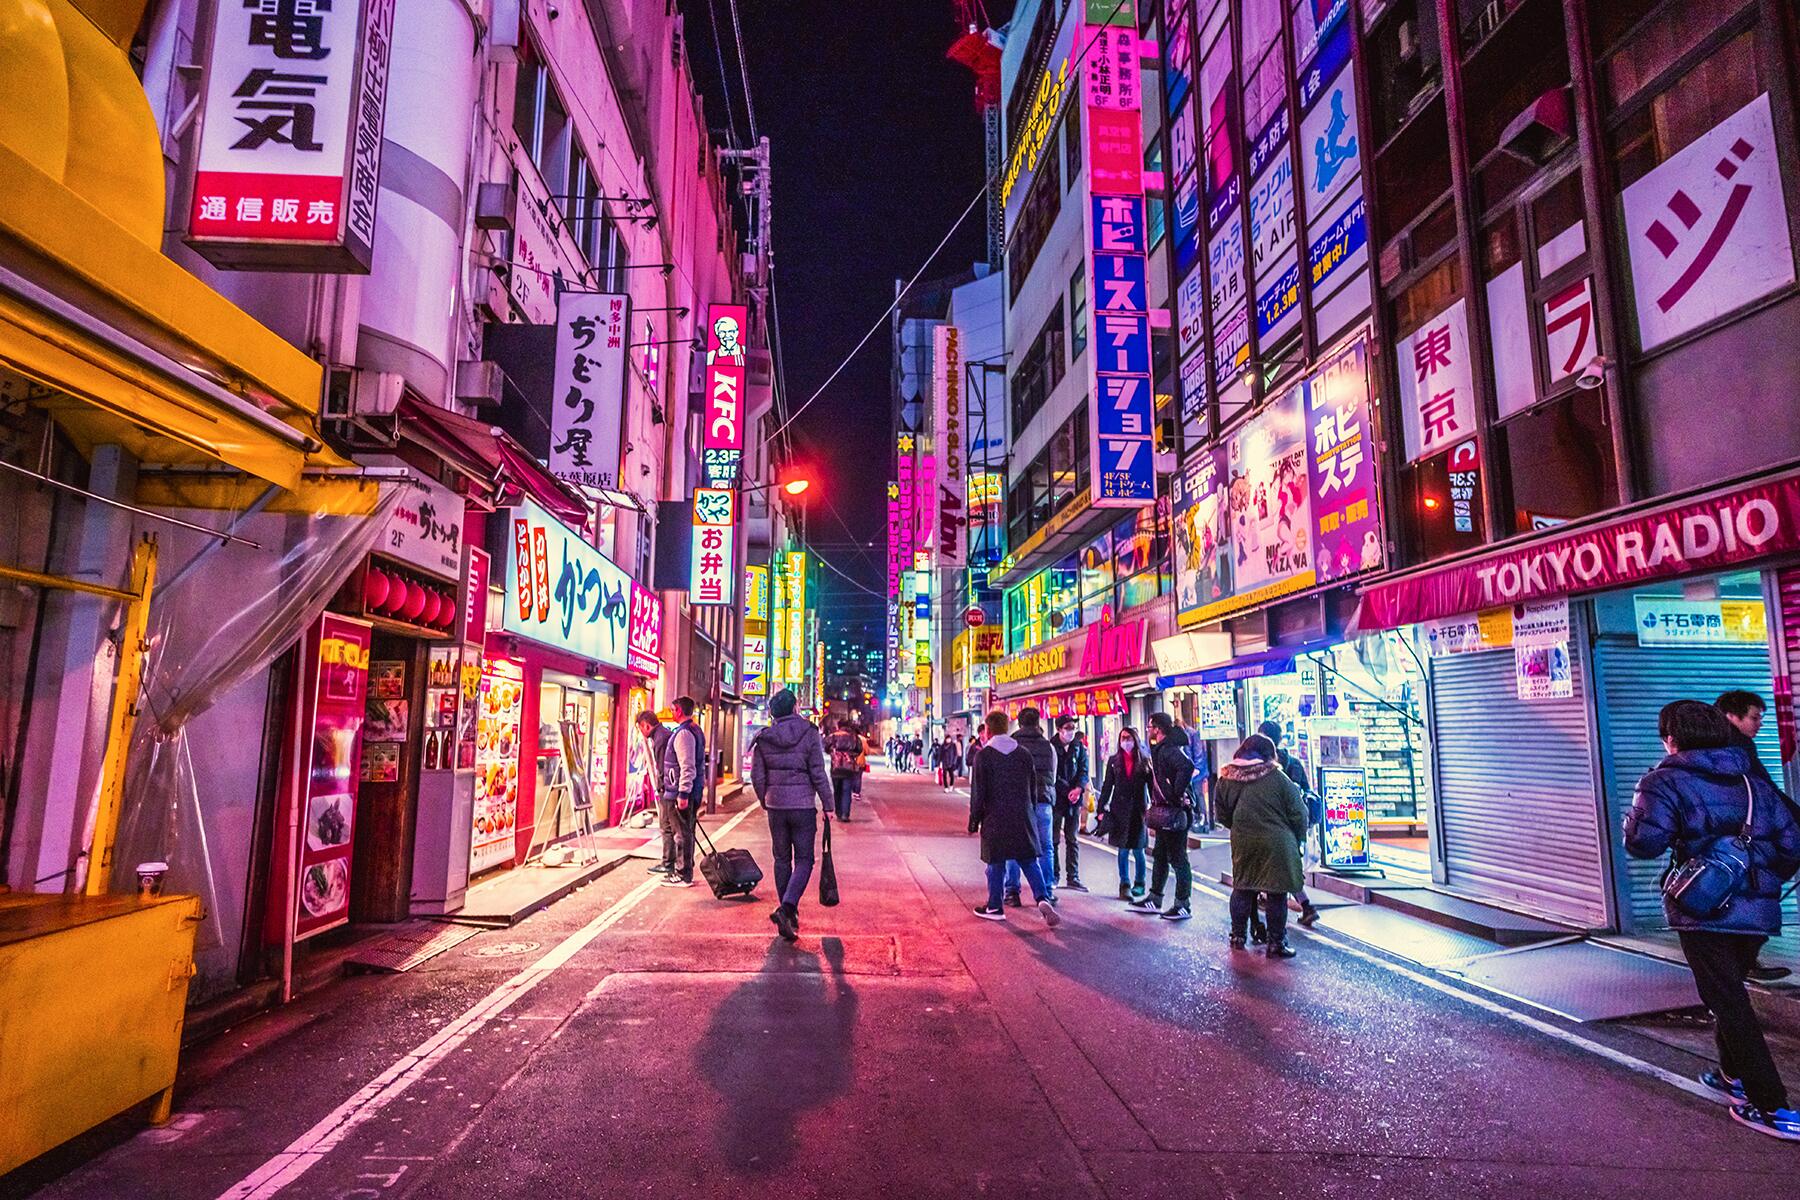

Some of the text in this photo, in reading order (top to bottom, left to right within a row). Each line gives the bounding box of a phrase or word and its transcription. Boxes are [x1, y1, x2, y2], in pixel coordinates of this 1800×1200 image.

[1002, 70, 1051, 208] PACHINKO
[1036, 57, 1068, 150] SLOT
[198, 196, 335, 225] 通信販売
[515, 274, 530, 306] 2F
[607, 299, 622, 349] 博多中洲
[1101, 197, 1143, 471] ホビーステーション
[1546, 281, 1591, 374] ラ
[553, 315, 606, 468] ぢどり屋
[711, 370, 738, 444] KFC
[1413, 323, 1459, 446] 東京
[1314, 395, 1361, 454] ホビ
[1317, 442, 1364, 499] ステ
[391, 529, 405, 549] 2F
[517, 523, 532, 609] とんかつ
[699, 528, 723, 601] お弁当
[1476, 497, 1780, 600] TOKYO RADIO
[554, 537, 627, 655] かつや
[633, 587, 660, 630] カツ丼
[1660, 613, 1721, 628] 千石電商
[632, 618, 658, 654] とんかつ
[1040, 645, 1066, 673] SLOT
